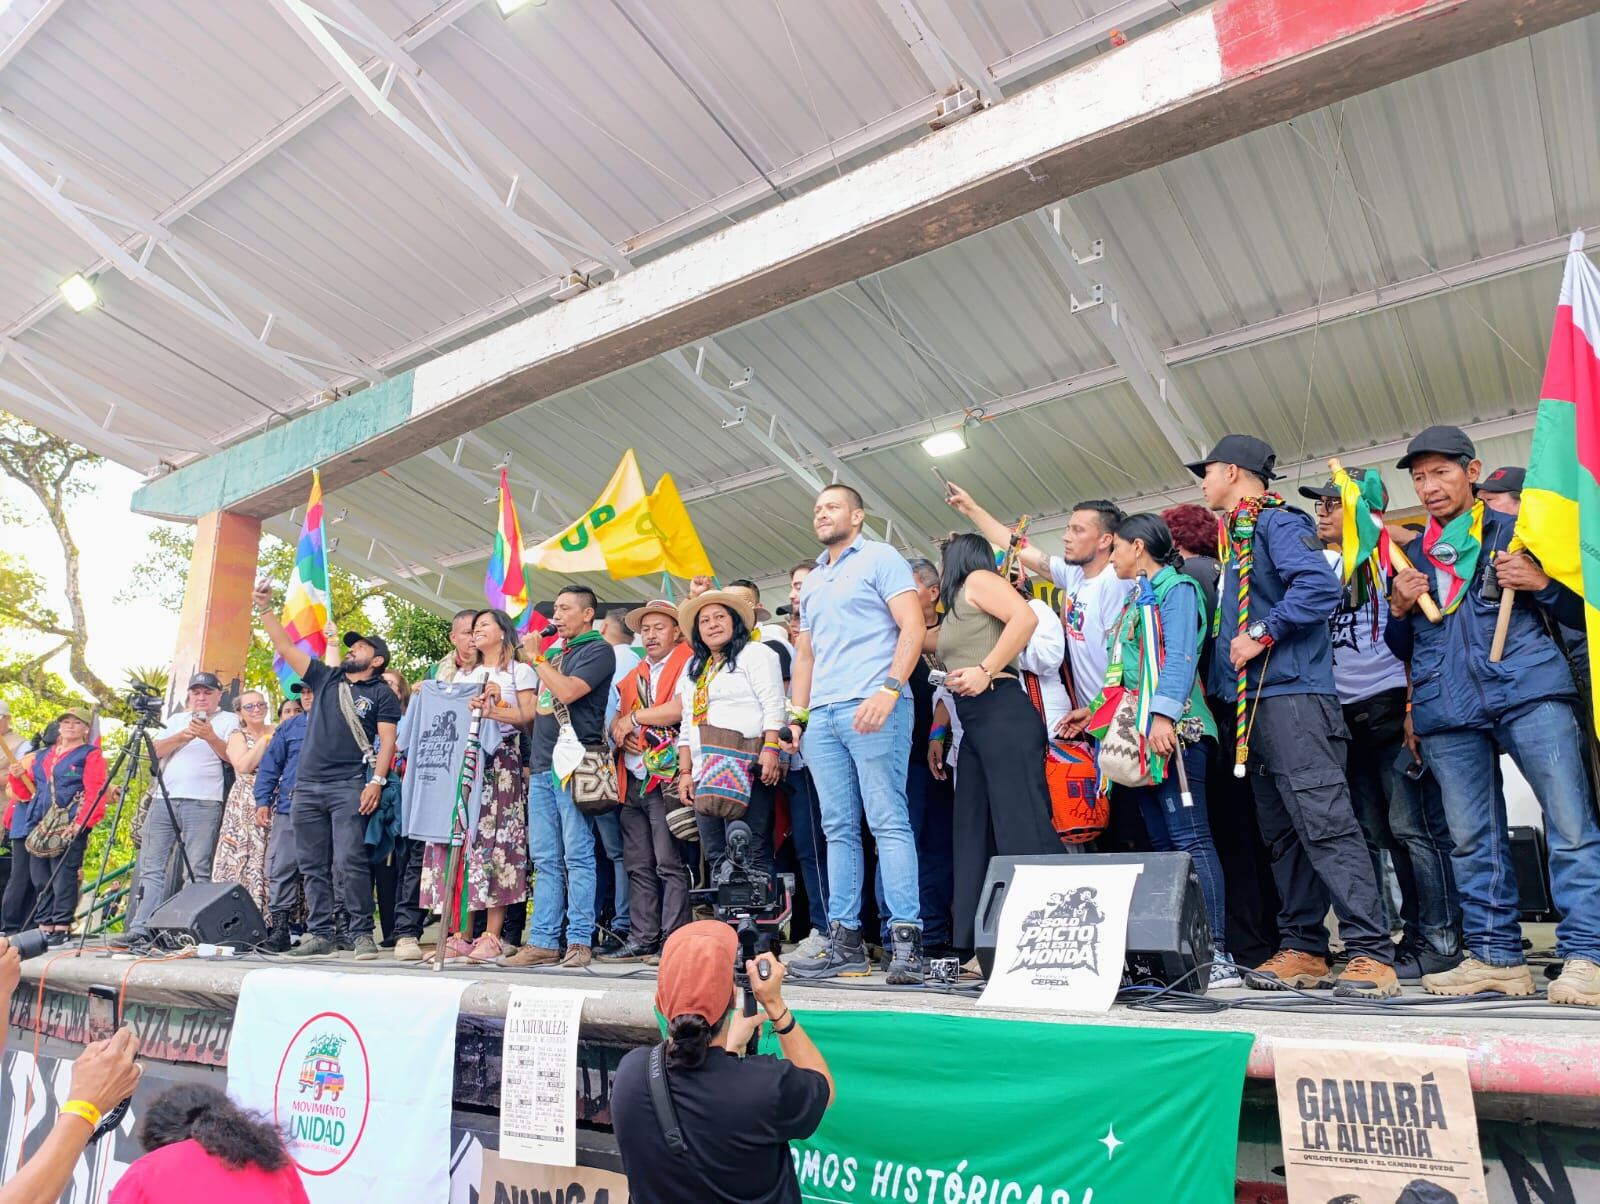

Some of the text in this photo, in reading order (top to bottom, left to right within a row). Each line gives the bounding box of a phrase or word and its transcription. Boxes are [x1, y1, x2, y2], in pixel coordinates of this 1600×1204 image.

[1040, 917, 1080, 927] SOLO
[1019, 925, 1095, 945] PACTO
[1051, 941, 1078, 949] ESTA
[1031, 978, 1069, 986] CEPEDA
[509, 1019, 518, 1033] LA
[1296, 1071, 1448, 1130] GANARÁ
[292, 1100, 346, 1118] MOVIMIENTO
[1301, 1120, 1433, 1158] LA ALEGRÍA
[1340, 1157, 1369, 1165] CEPEDA
[1376, 1159, 1387, 1167] EL
[1387, 1160, 1418, 1169] CAMBIO
